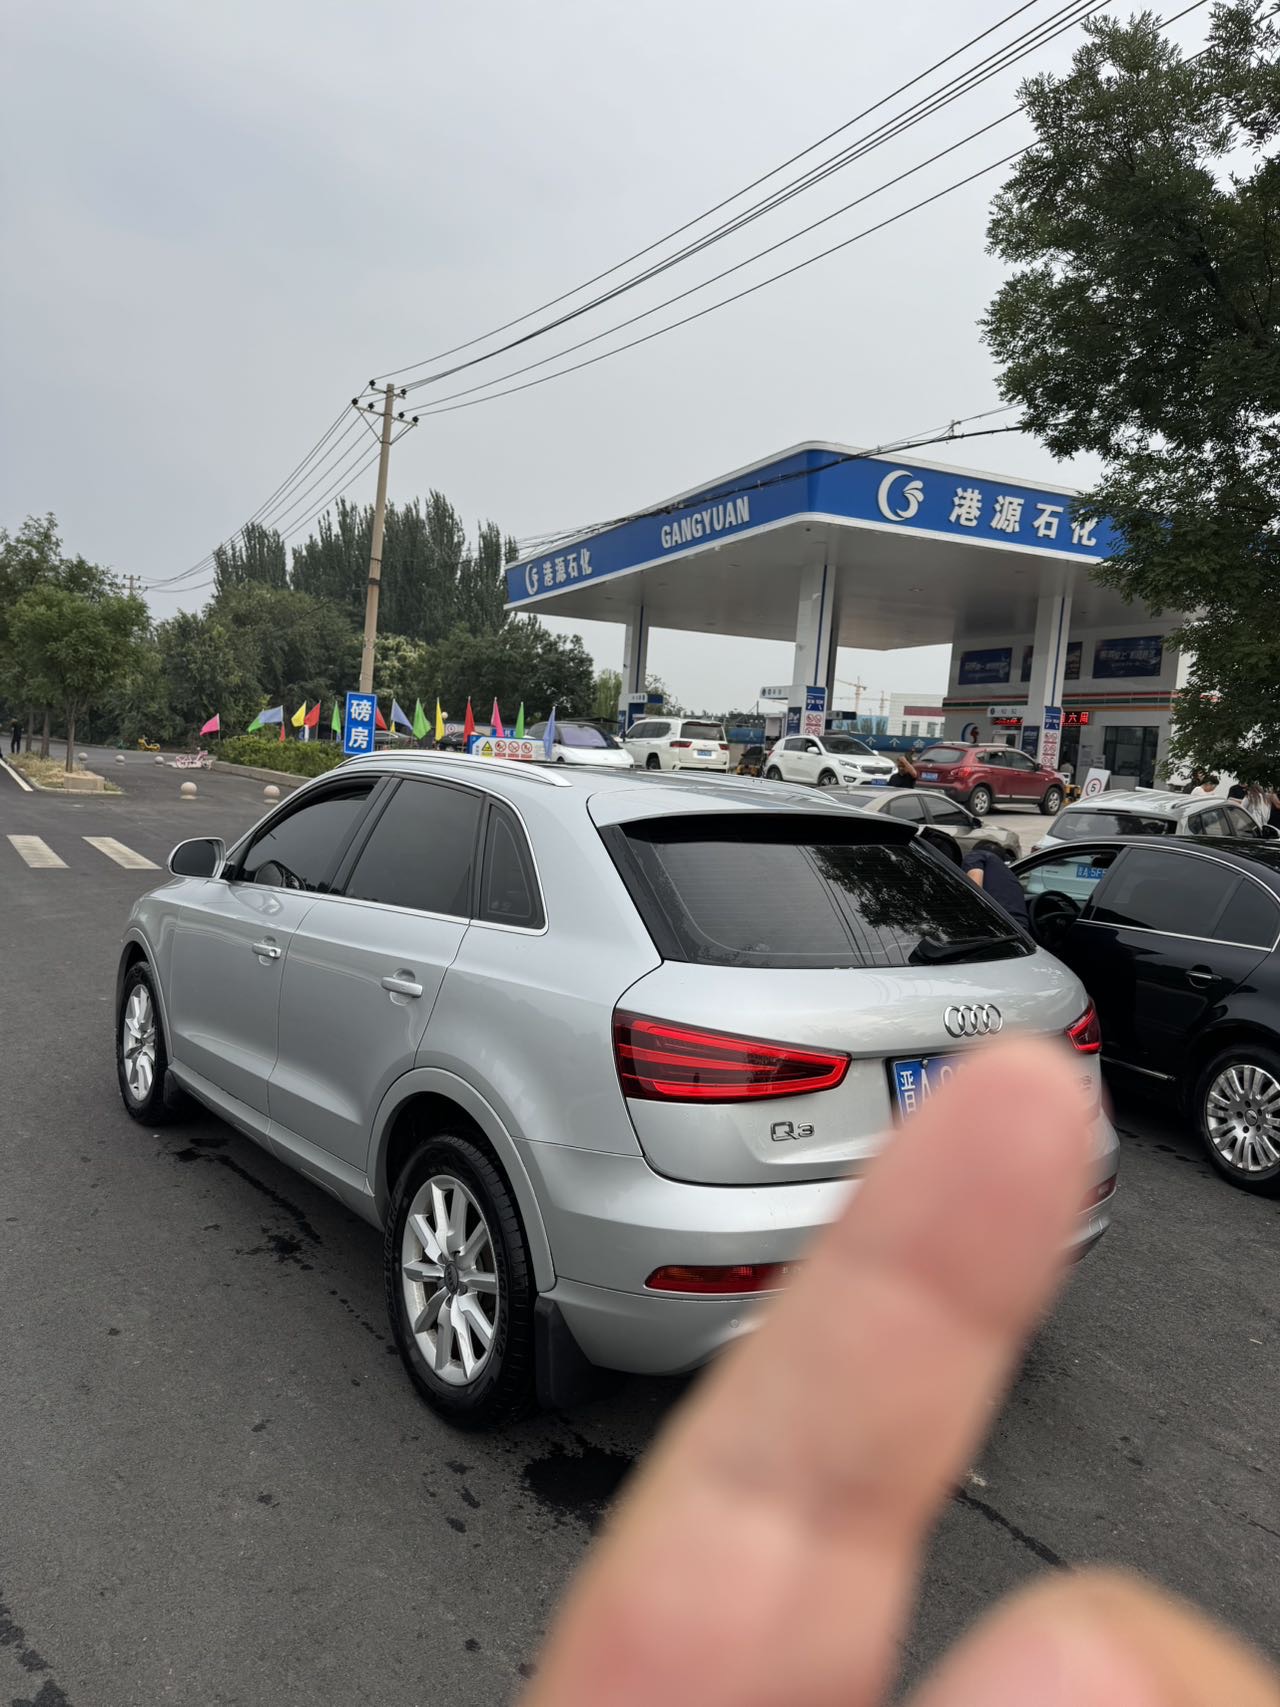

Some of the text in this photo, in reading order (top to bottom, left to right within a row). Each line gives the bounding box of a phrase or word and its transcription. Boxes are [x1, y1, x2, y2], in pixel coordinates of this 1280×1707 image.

[661, 496, 750, 549] GANGYUAN
[949, 487, 1099, 547] 港源石化
[543, 548, 592, 587] 港源石化
[348, 699, 372, 749] 磅房
[1090, 783, 1097, 793] 5
[770, 1121, 815, 1142] Q3
